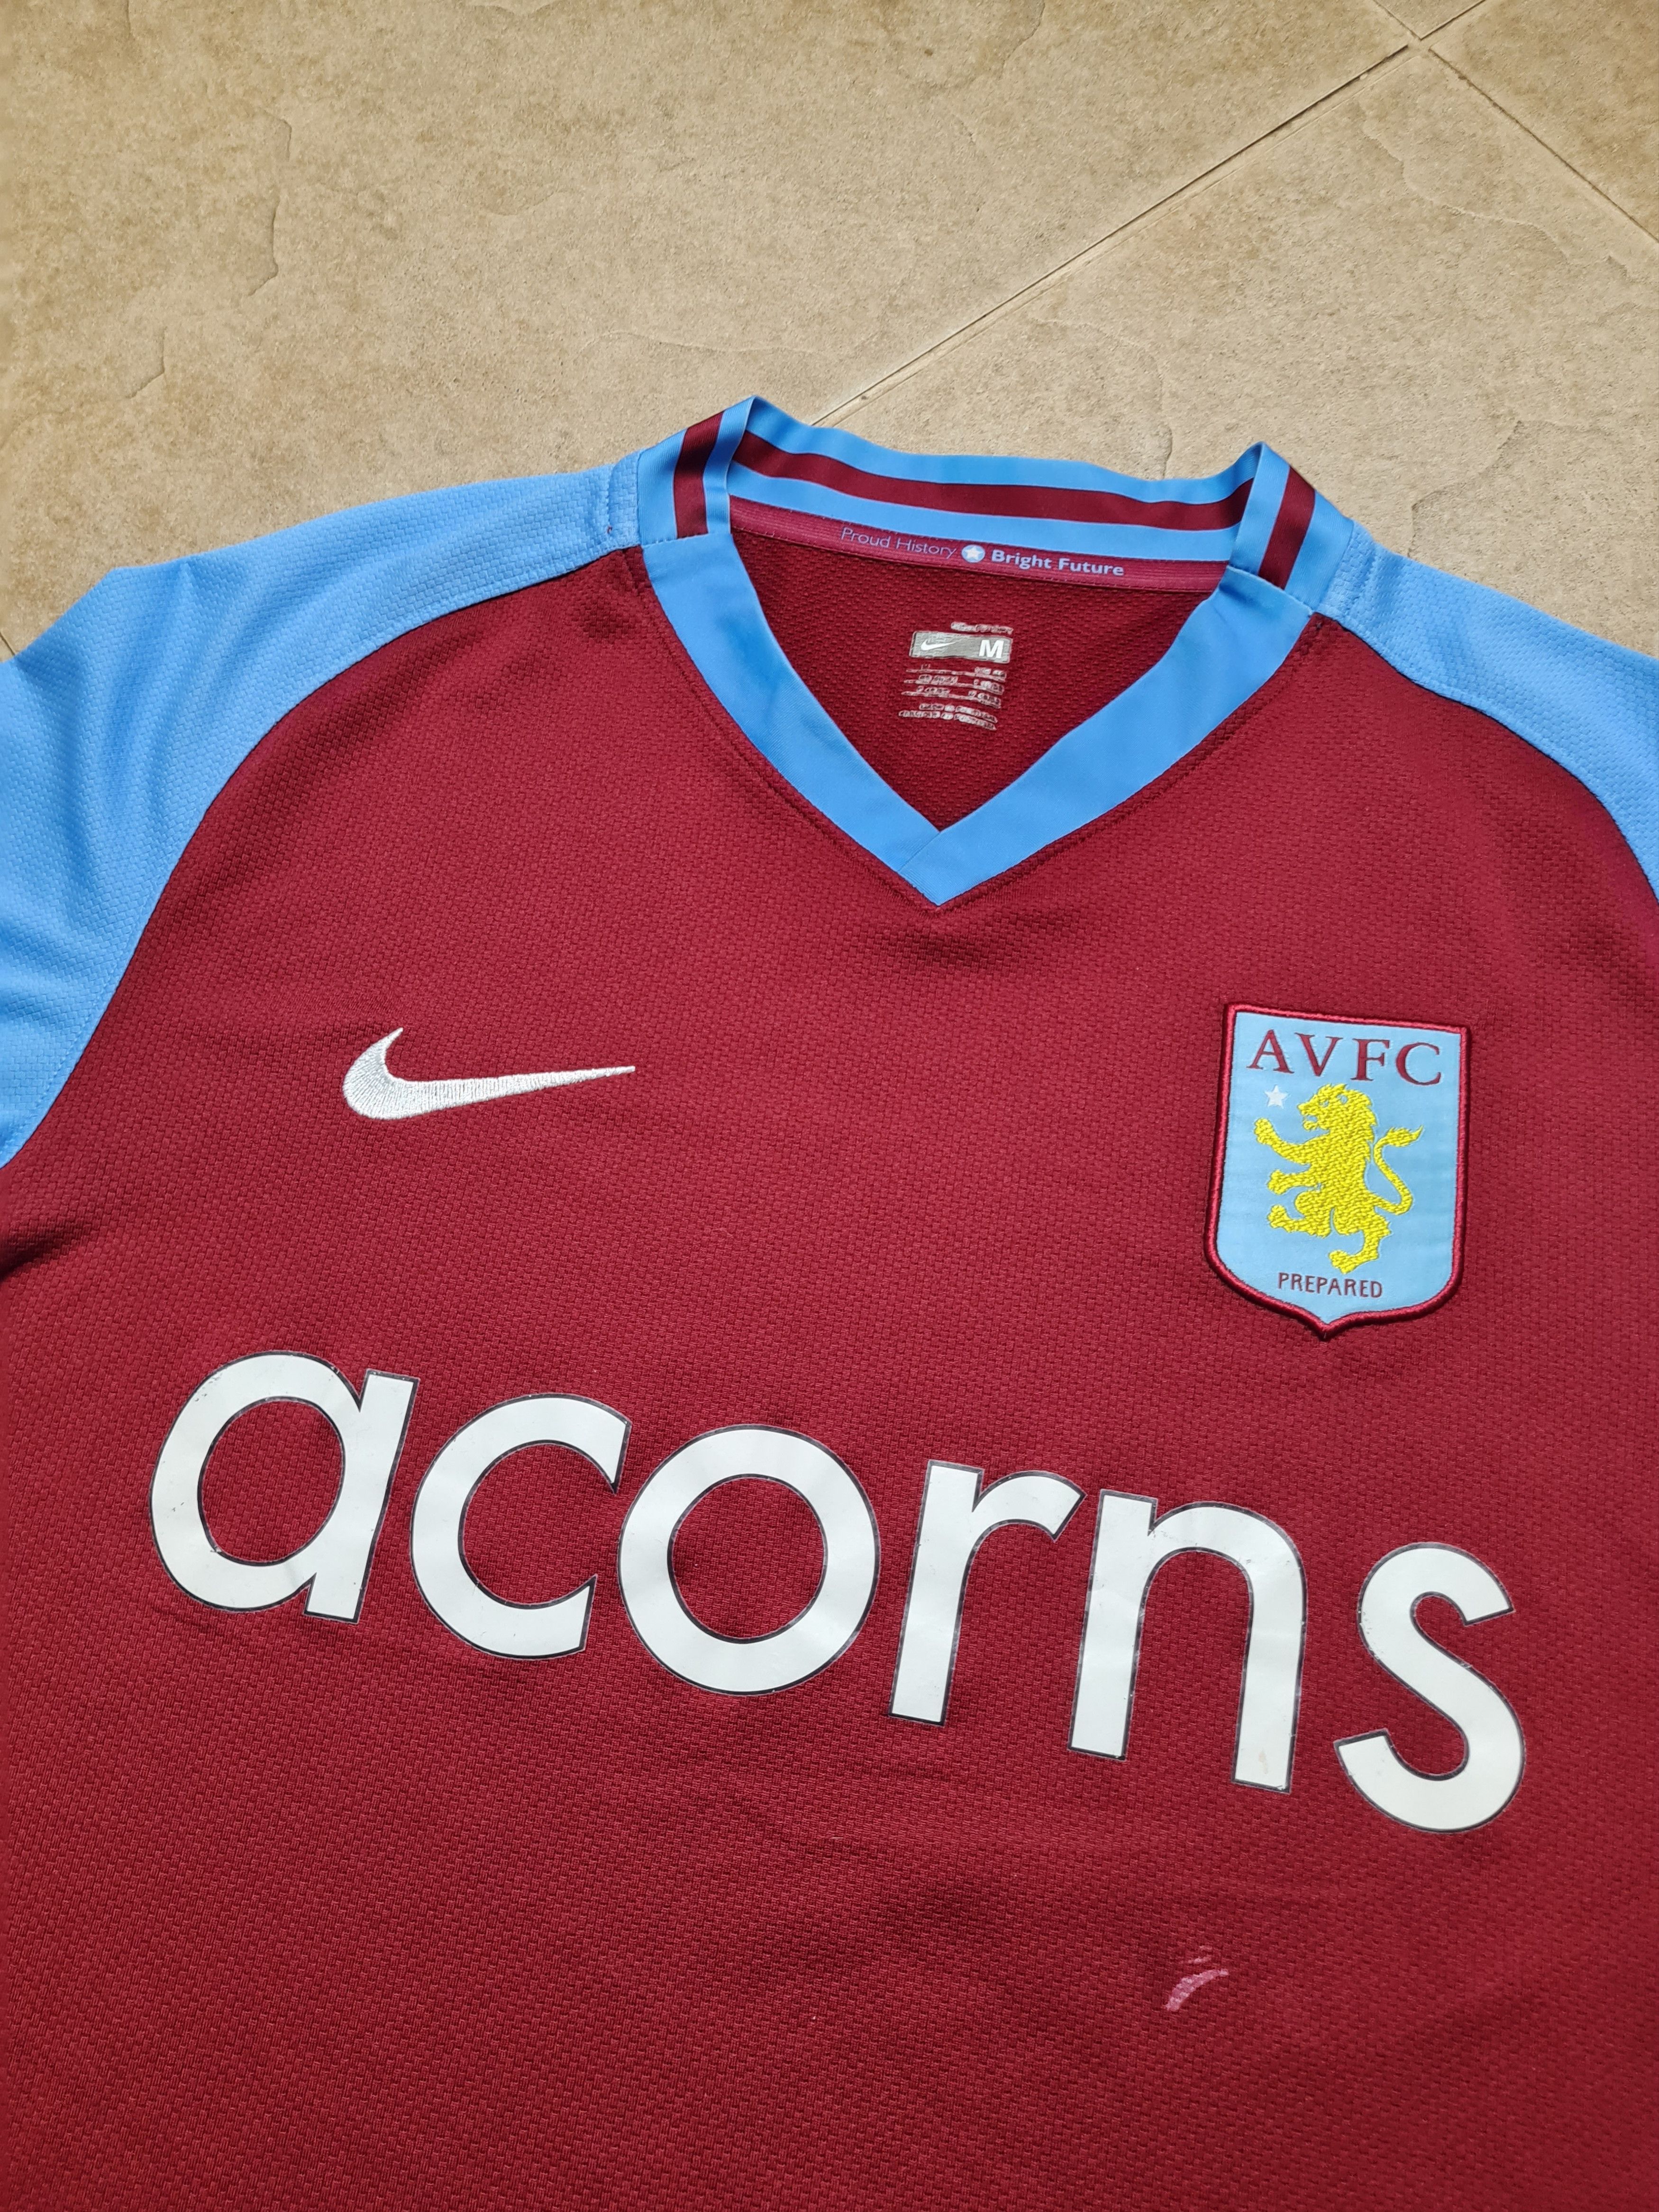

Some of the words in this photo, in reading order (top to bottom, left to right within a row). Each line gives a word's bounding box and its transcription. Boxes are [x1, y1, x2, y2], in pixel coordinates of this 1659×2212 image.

[841, 528, 890, 548] Proud
[895, 537, 957, 559] History
[992, 550, 1051, 570] Bright
[1058, 559, 1124, 576] Future
[978, 639, 1004, 659] M
[1247, 1029, 1442, 1085] AVFC
[1278, 1272, 1383, 1298] PREPARED
[149, 1351, 1526, 1831] acorns
